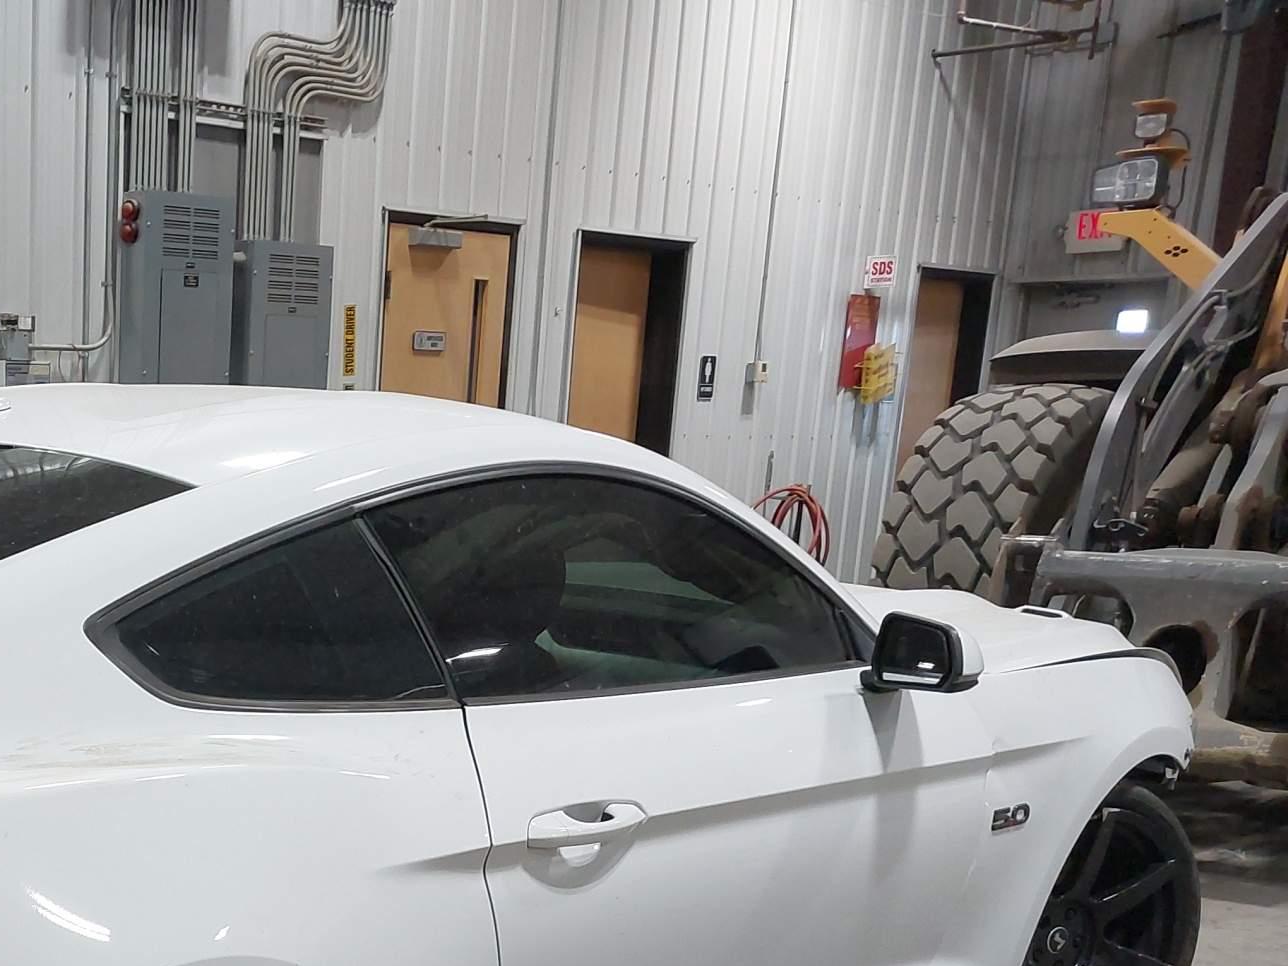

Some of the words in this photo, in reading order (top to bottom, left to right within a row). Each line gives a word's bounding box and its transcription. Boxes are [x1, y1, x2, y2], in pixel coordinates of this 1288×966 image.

[1078, 212, 1112, 240] EX
[872, 260, 893, 276] SDS
[346, 306, 356, 336] DRIVER
[345, 338, 354, 374] STUDENT
